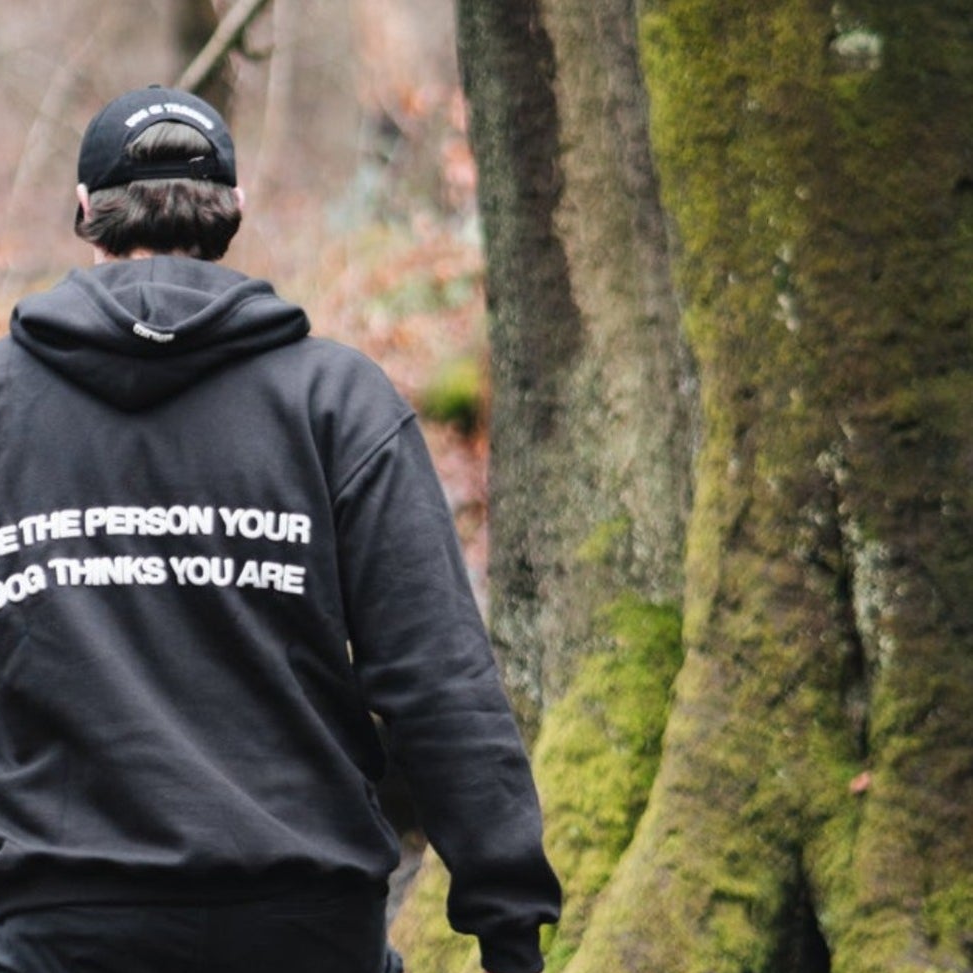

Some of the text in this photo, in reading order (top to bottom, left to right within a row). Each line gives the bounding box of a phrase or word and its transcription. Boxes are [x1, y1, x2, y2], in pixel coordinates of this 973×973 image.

[19, 509, 82, 546] THE
[84, 505, 214, 537] PERSON
[219, 507, 312, 544] YOUR
[48, 556, 168, 586] THINKS
[170, 556, 234, 587] YOU
[237, 561, 306, 595] ARE
